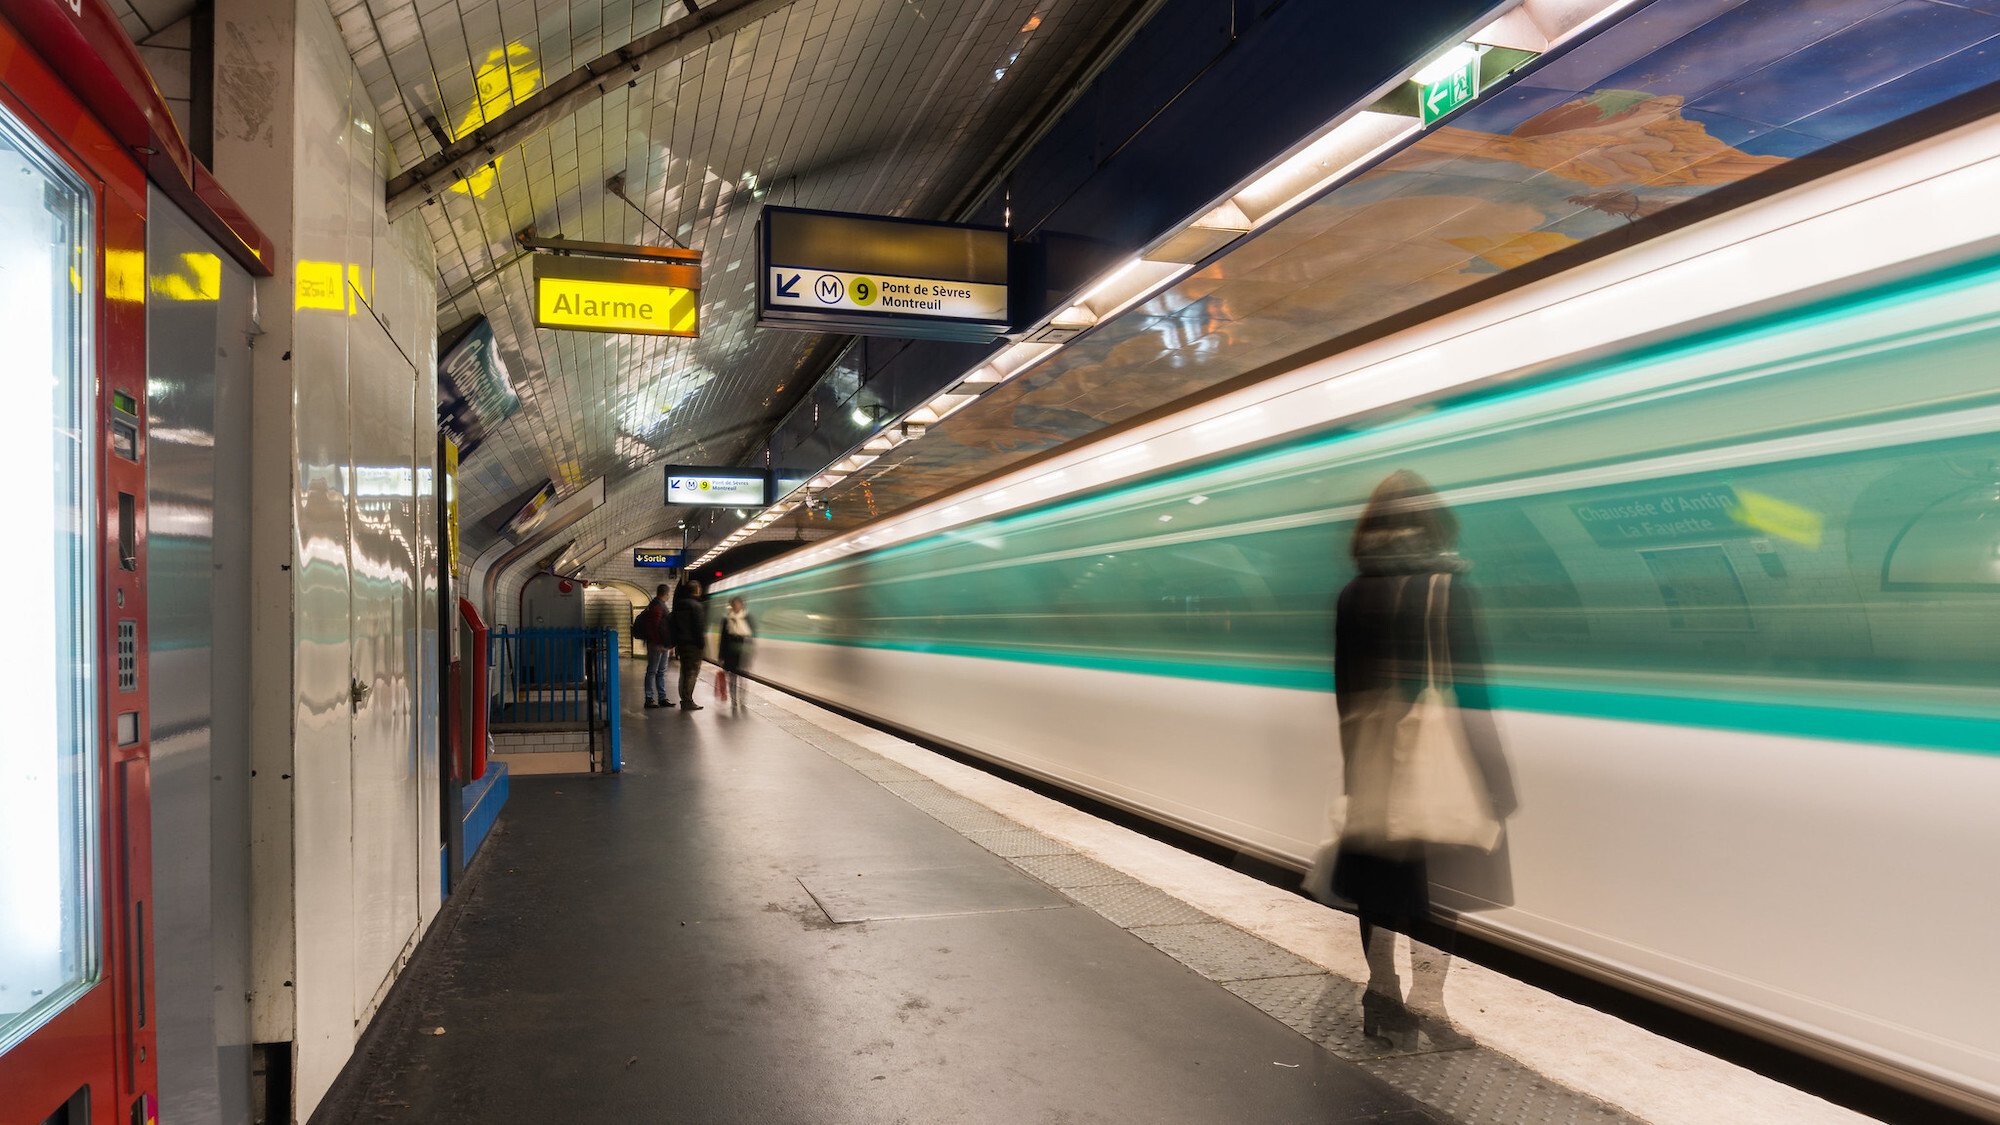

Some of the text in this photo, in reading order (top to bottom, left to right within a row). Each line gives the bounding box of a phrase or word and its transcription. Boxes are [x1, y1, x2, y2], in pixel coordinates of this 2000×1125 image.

[856, 283, 870, 301] 9
[882, 281, 910, 295] Pont
[914, 284, 928, 296] de
[932, 285, 971, 299] Sèvres
[552, 293, 653, 320] Alarme
[882, 297, 941, 311] Montreuil
[1578, 491, 1733, 522] Chaussée d'Antin
[1618, 517, 1715, 539] La Fayette
[643, 554, 666, 562] Sortie
